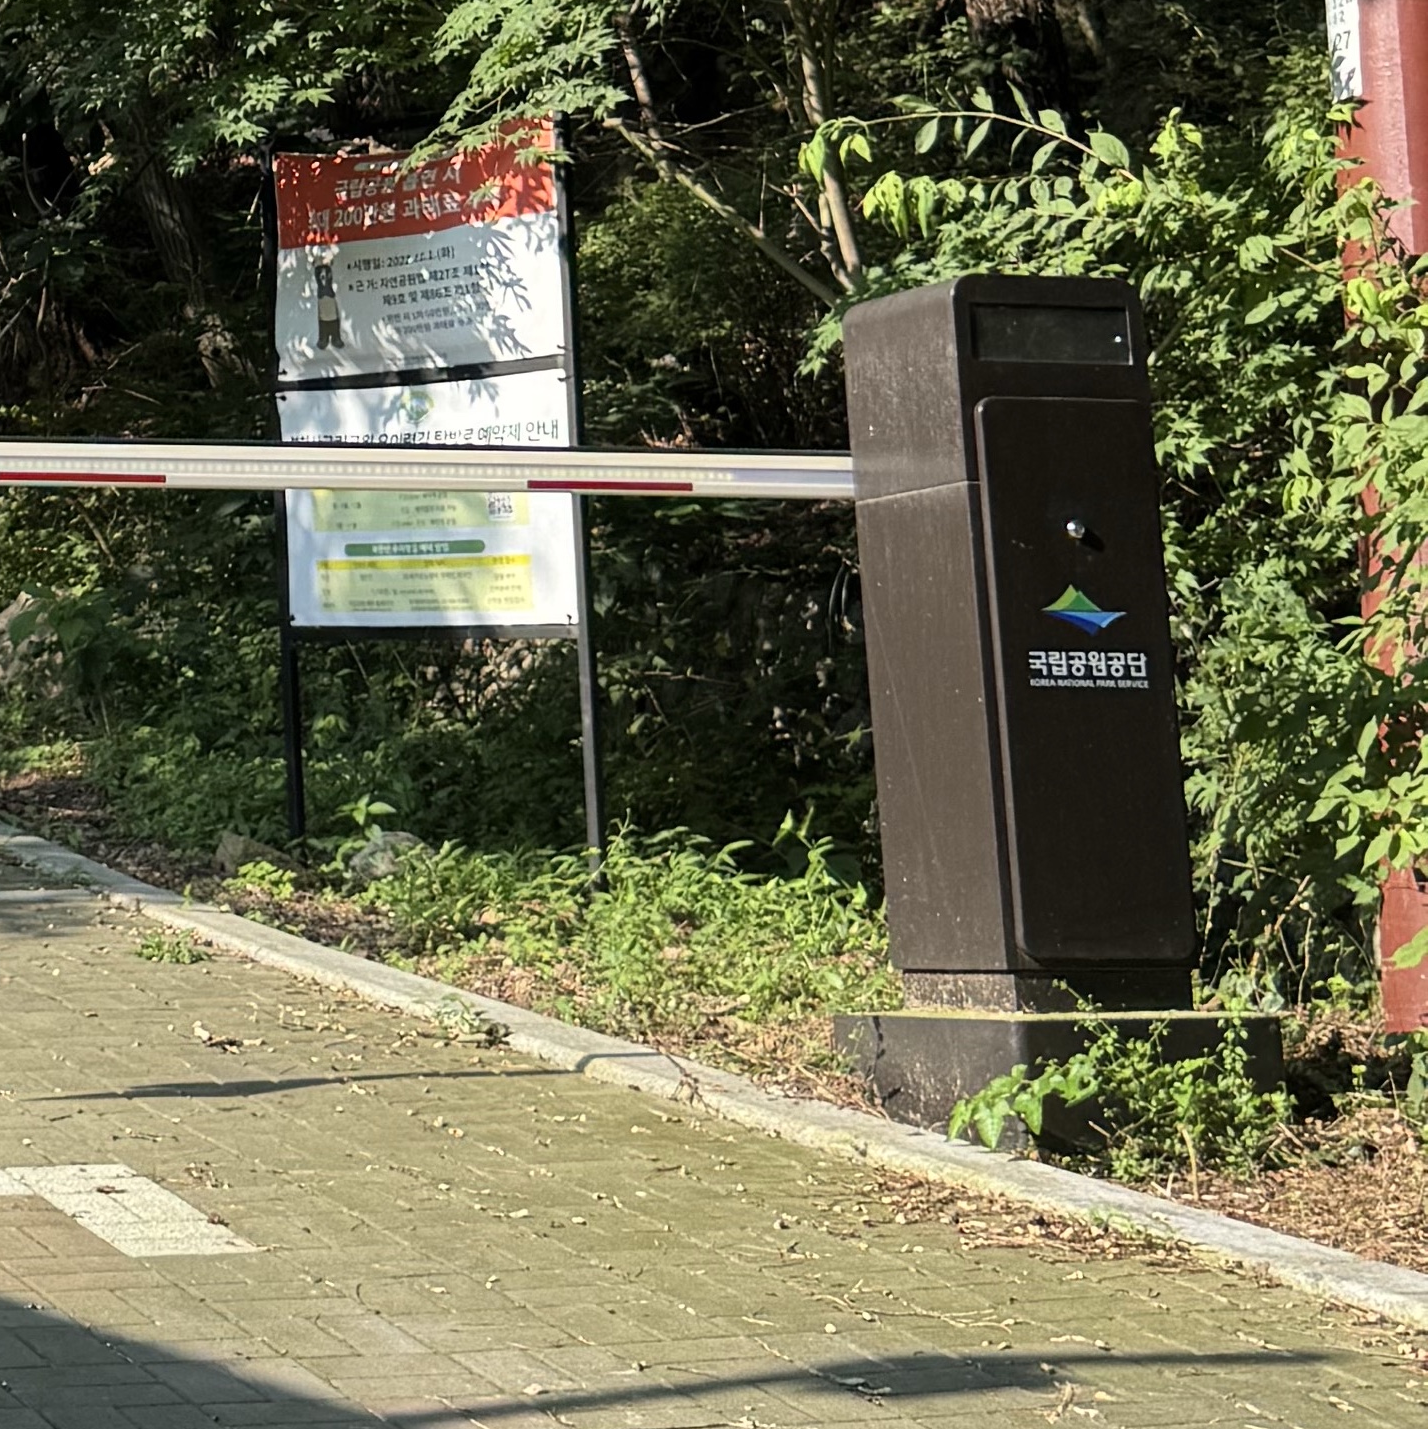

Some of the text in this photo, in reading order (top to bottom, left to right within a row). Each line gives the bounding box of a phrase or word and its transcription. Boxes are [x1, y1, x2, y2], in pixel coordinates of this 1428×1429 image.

[477, 423, 522, 444] 예약제
[525, 418, 559, 442] 안내
[1029, 651, 1146, 677] 국립공원공단
